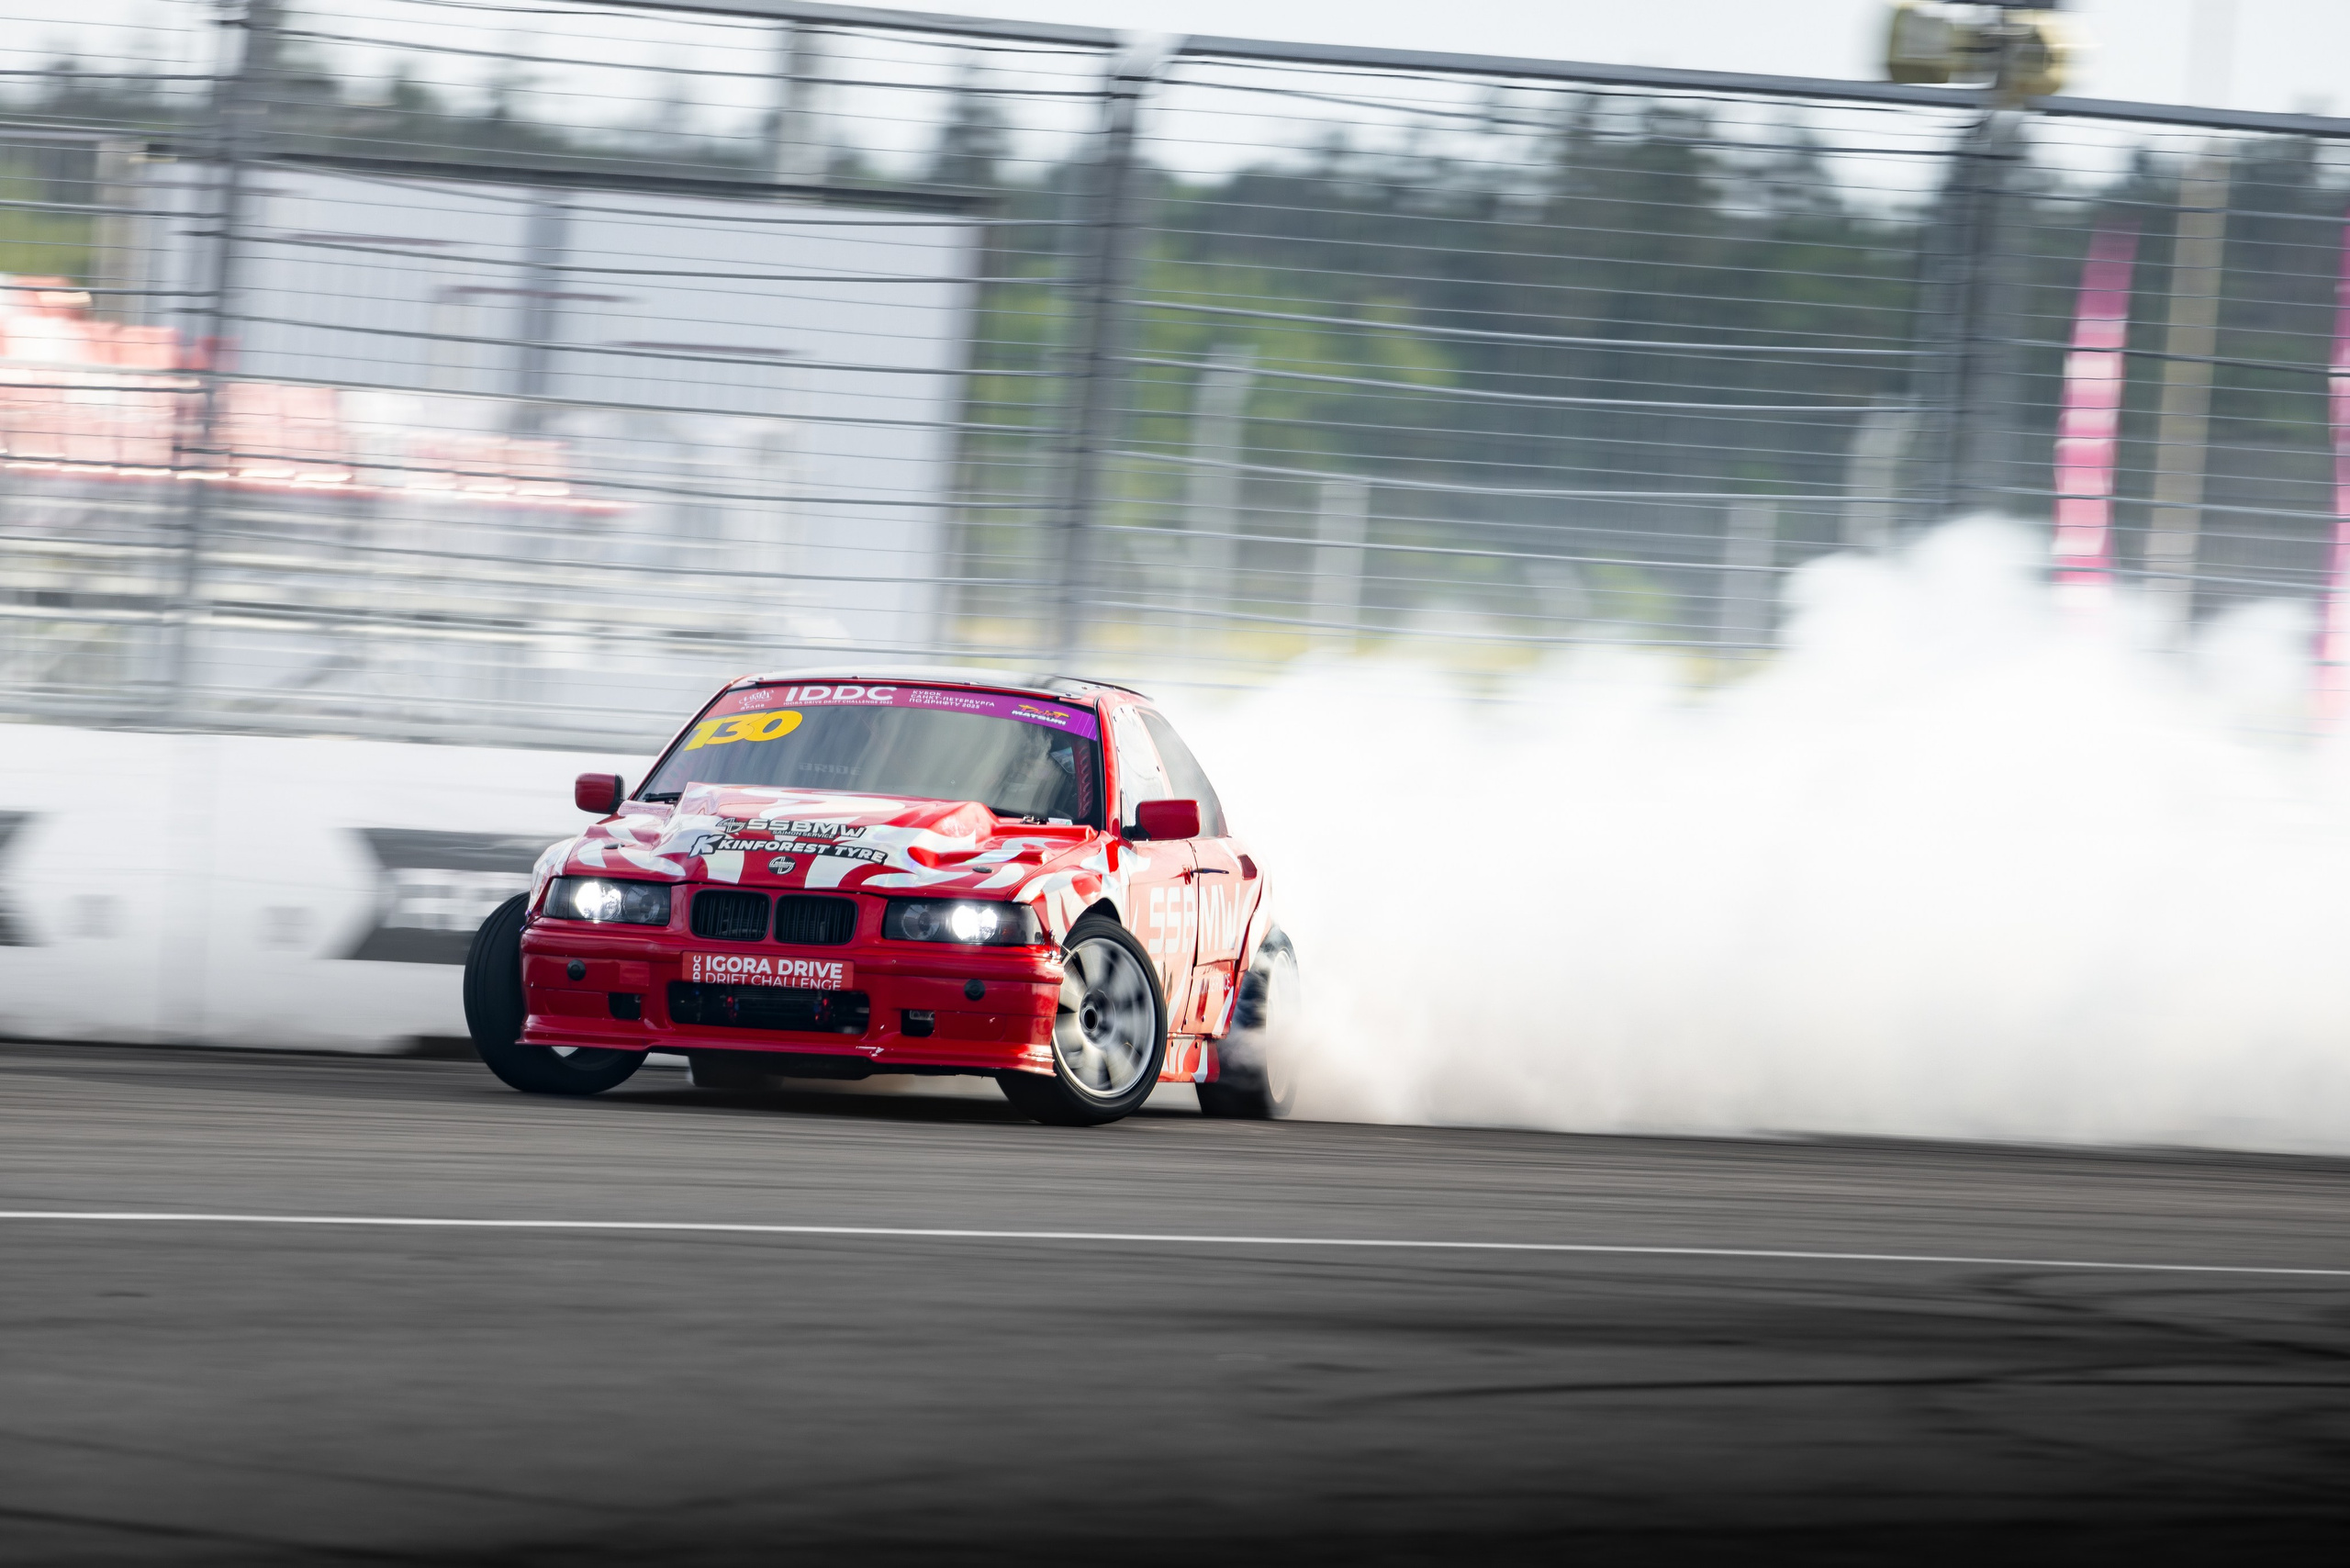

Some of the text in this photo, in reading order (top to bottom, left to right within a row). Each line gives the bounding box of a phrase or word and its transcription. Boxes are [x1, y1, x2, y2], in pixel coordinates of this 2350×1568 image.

[786, 686, 898, 701] IDDC
[911, 694, 995, 707] САНКТ-ПЕТЕРБУРГА
[923, 699, 960, 707] ДРИФТУ
[683, 711, 803, 751] 130
[747, 818, 867, 837] SSBMW
[718, 839, 888, 863] KINFOREST TYRE
[706, 956, 843, 979] IGORA DRIVE
[706, 972, 842, 991] DRIFT CHALLENGE
